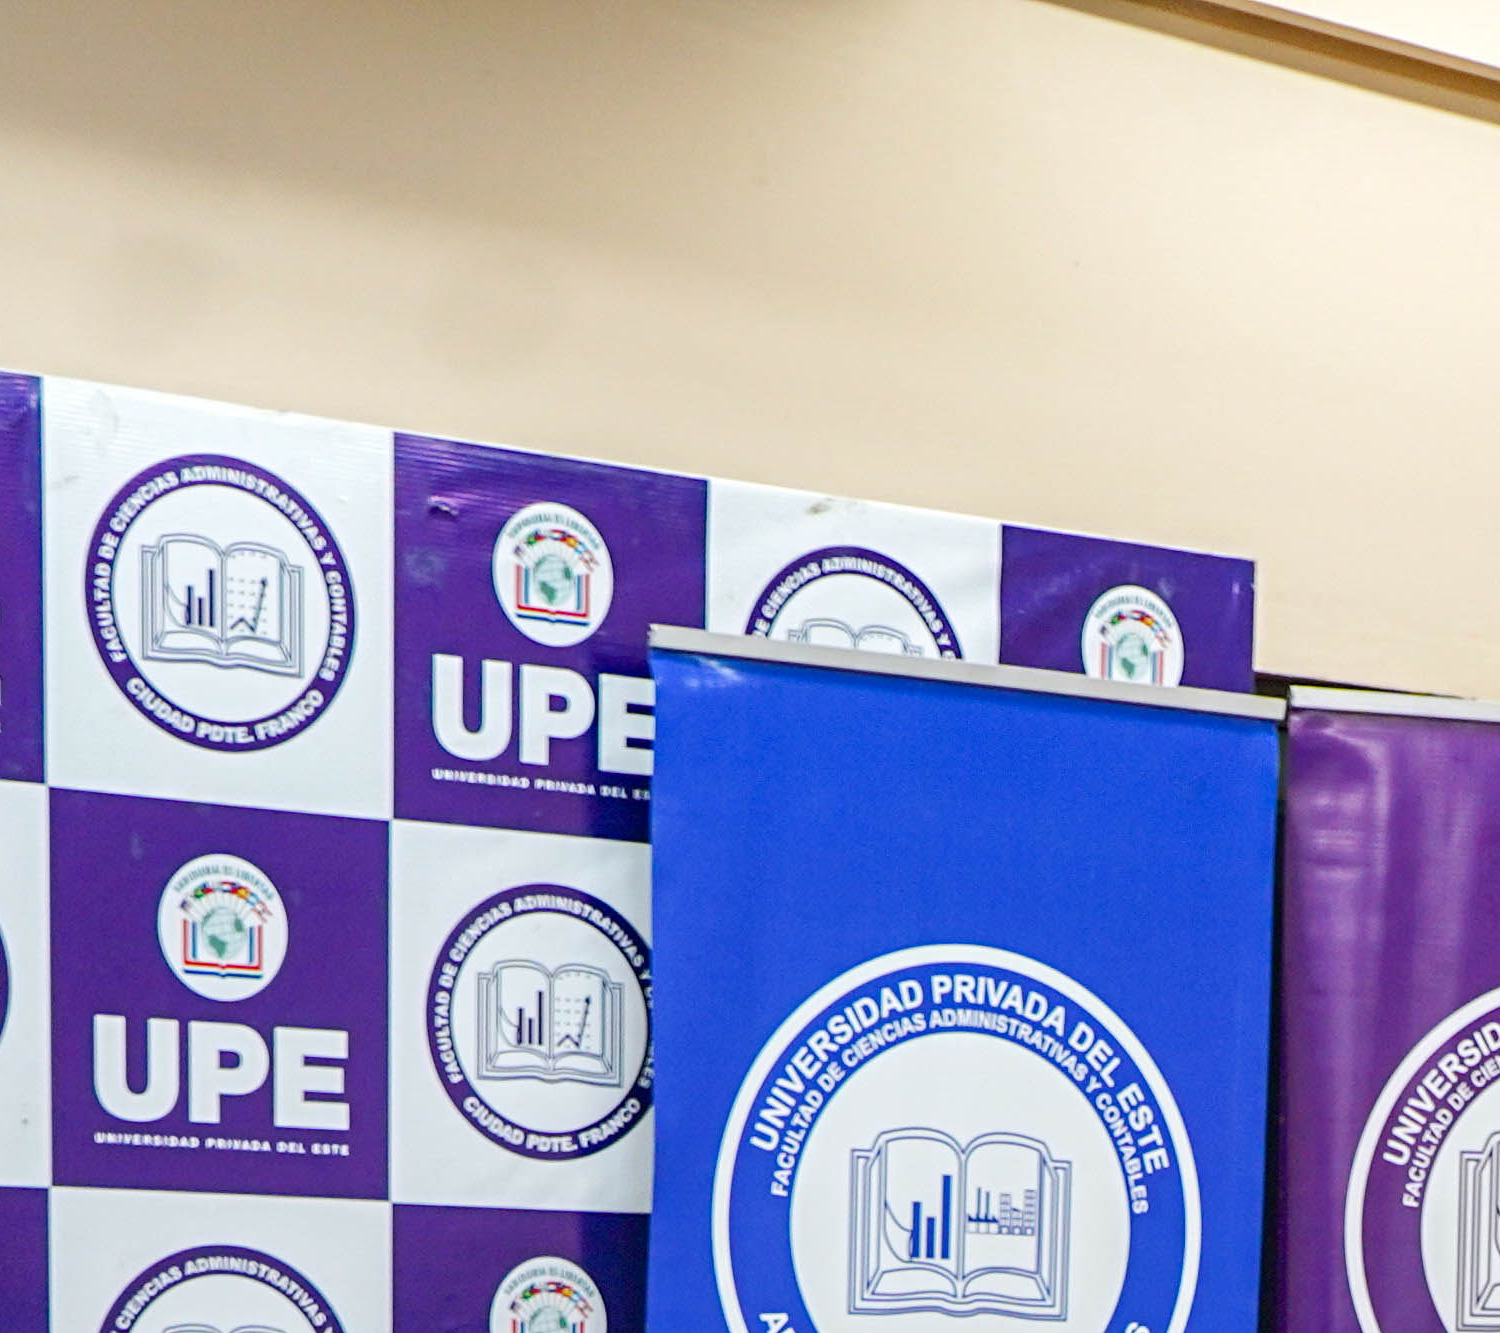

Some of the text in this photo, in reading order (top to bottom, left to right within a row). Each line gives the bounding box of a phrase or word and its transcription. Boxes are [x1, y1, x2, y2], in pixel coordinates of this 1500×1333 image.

[432, 653, 652, 780] UPE
[94, 1014, 349, 1132] UPE
[750, 974, 1169, 1175] UNIVERSIDAD PRIVADA DEL ESTE
[771, 1009, 1149, 1215] FACULTAD DE CIENCIAS ADMINISTRATIVAS Y CONTABLES
[94, 1132, 349, 1155] UNIVERSIDAD PRIVADA DEL ESTE
[1402, 1107, 1454, 1207] FACULTAD
[1448, 1081, 1473, 1112] DE
[114, 1265, 184, 1333] CIENCIAS
[182, 1257, 326, 1327] ADMINISTRATIVAS
